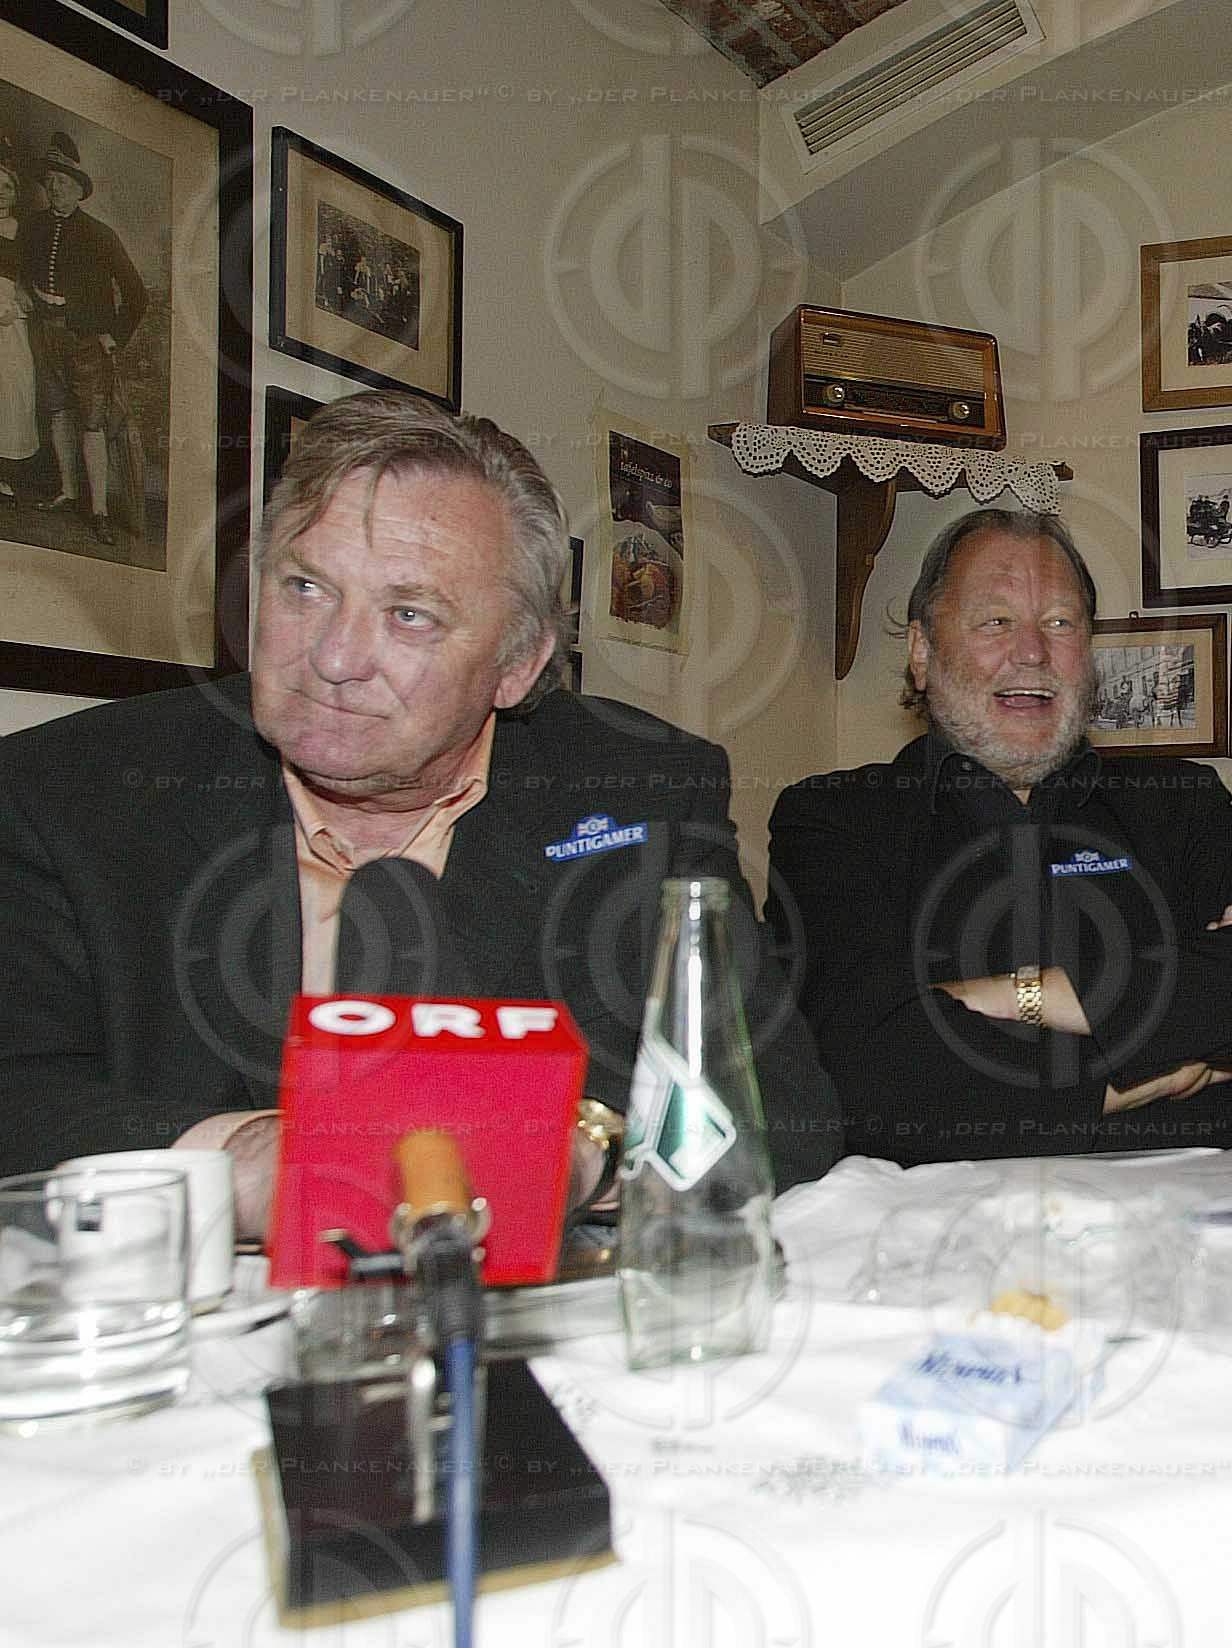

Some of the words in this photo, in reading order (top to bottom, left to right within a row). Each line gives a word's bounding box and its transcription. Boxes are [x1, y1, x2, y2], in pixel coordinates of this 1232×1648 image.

[544, 825, 644, 859] PUNTIGAMER
[1050, 857, 1129, 876] PUNTIGAMER
[307, 999, 559, 1041] ORF
